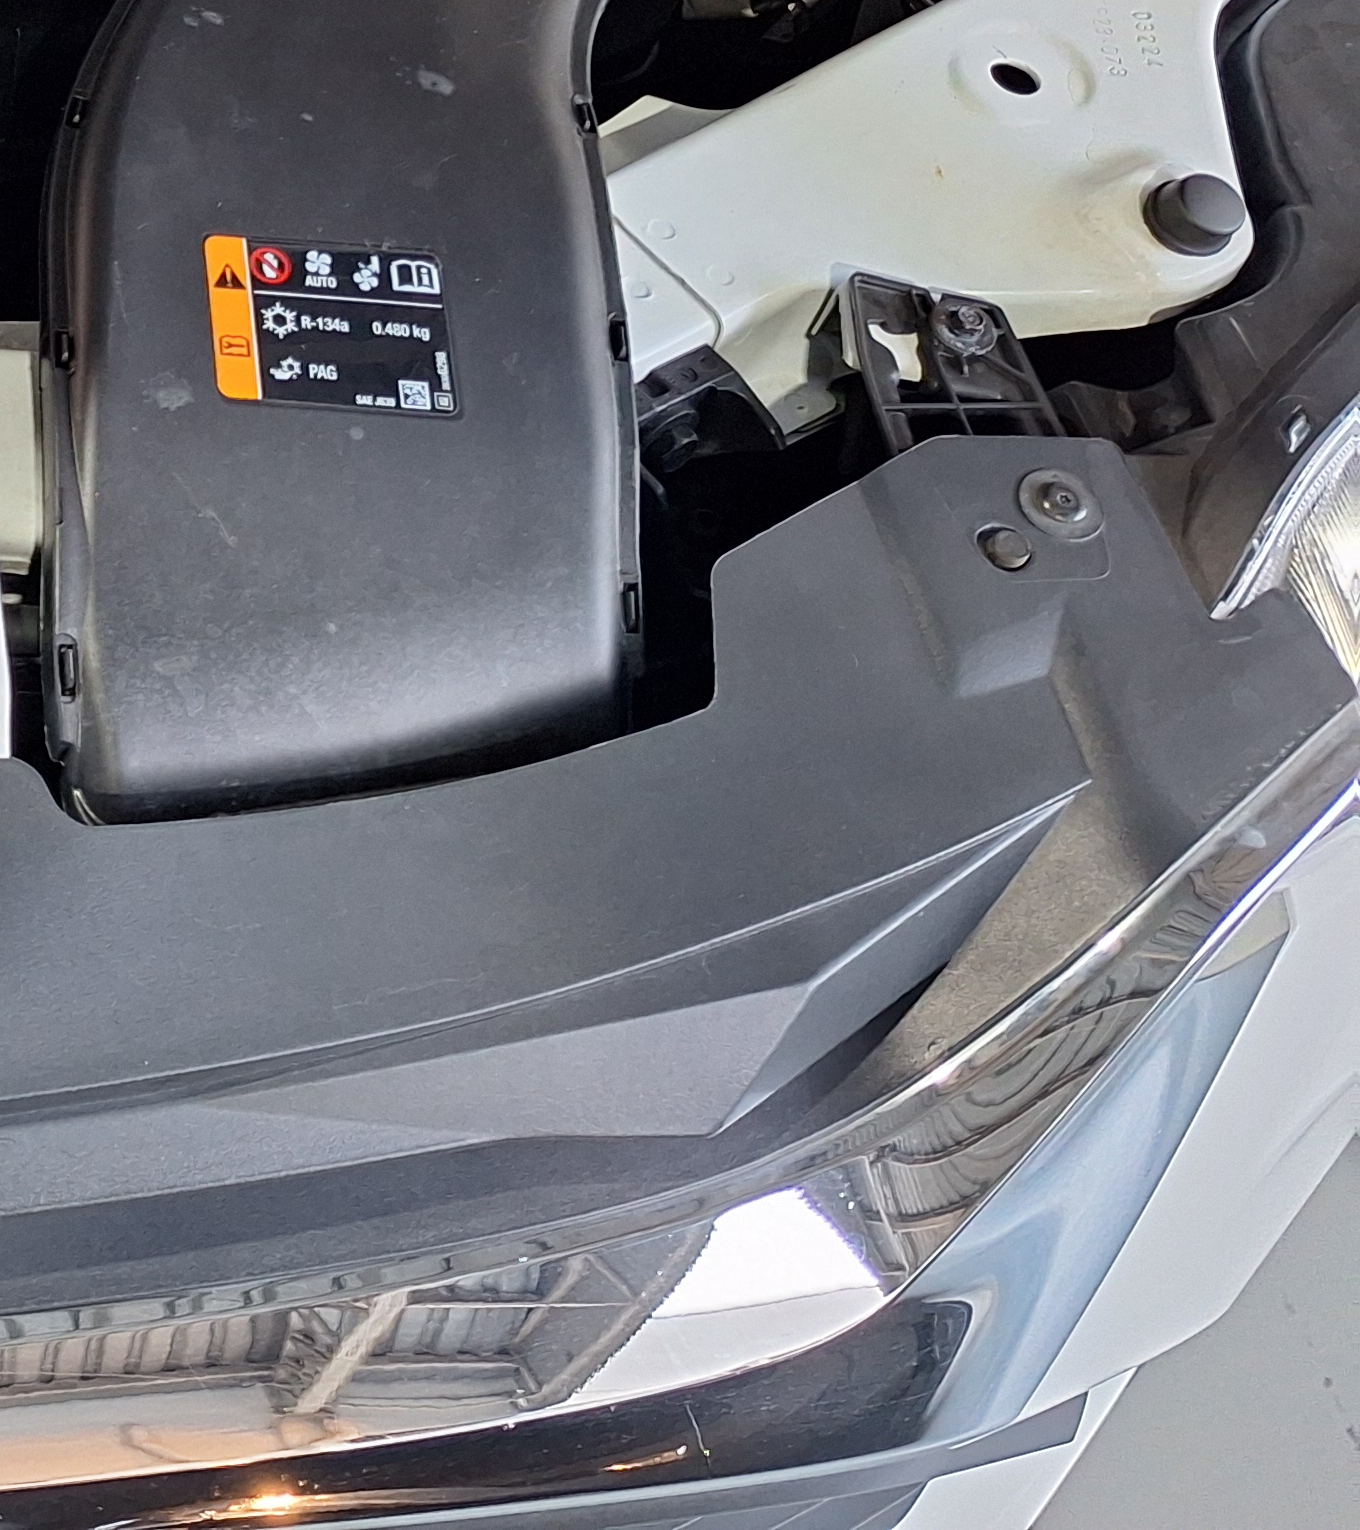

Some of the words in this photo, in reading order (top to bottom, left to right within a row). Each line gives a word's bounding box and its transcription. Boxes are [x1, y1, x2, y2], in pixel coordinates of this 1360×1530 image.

[305, 275, 338, 289] AUTO
[300, 316, 350, 334] R-134a
[371, 321, 409, 337] 0.480
[411, 324, 431, 342] kg
[308, 364, 338, 381] PAG
